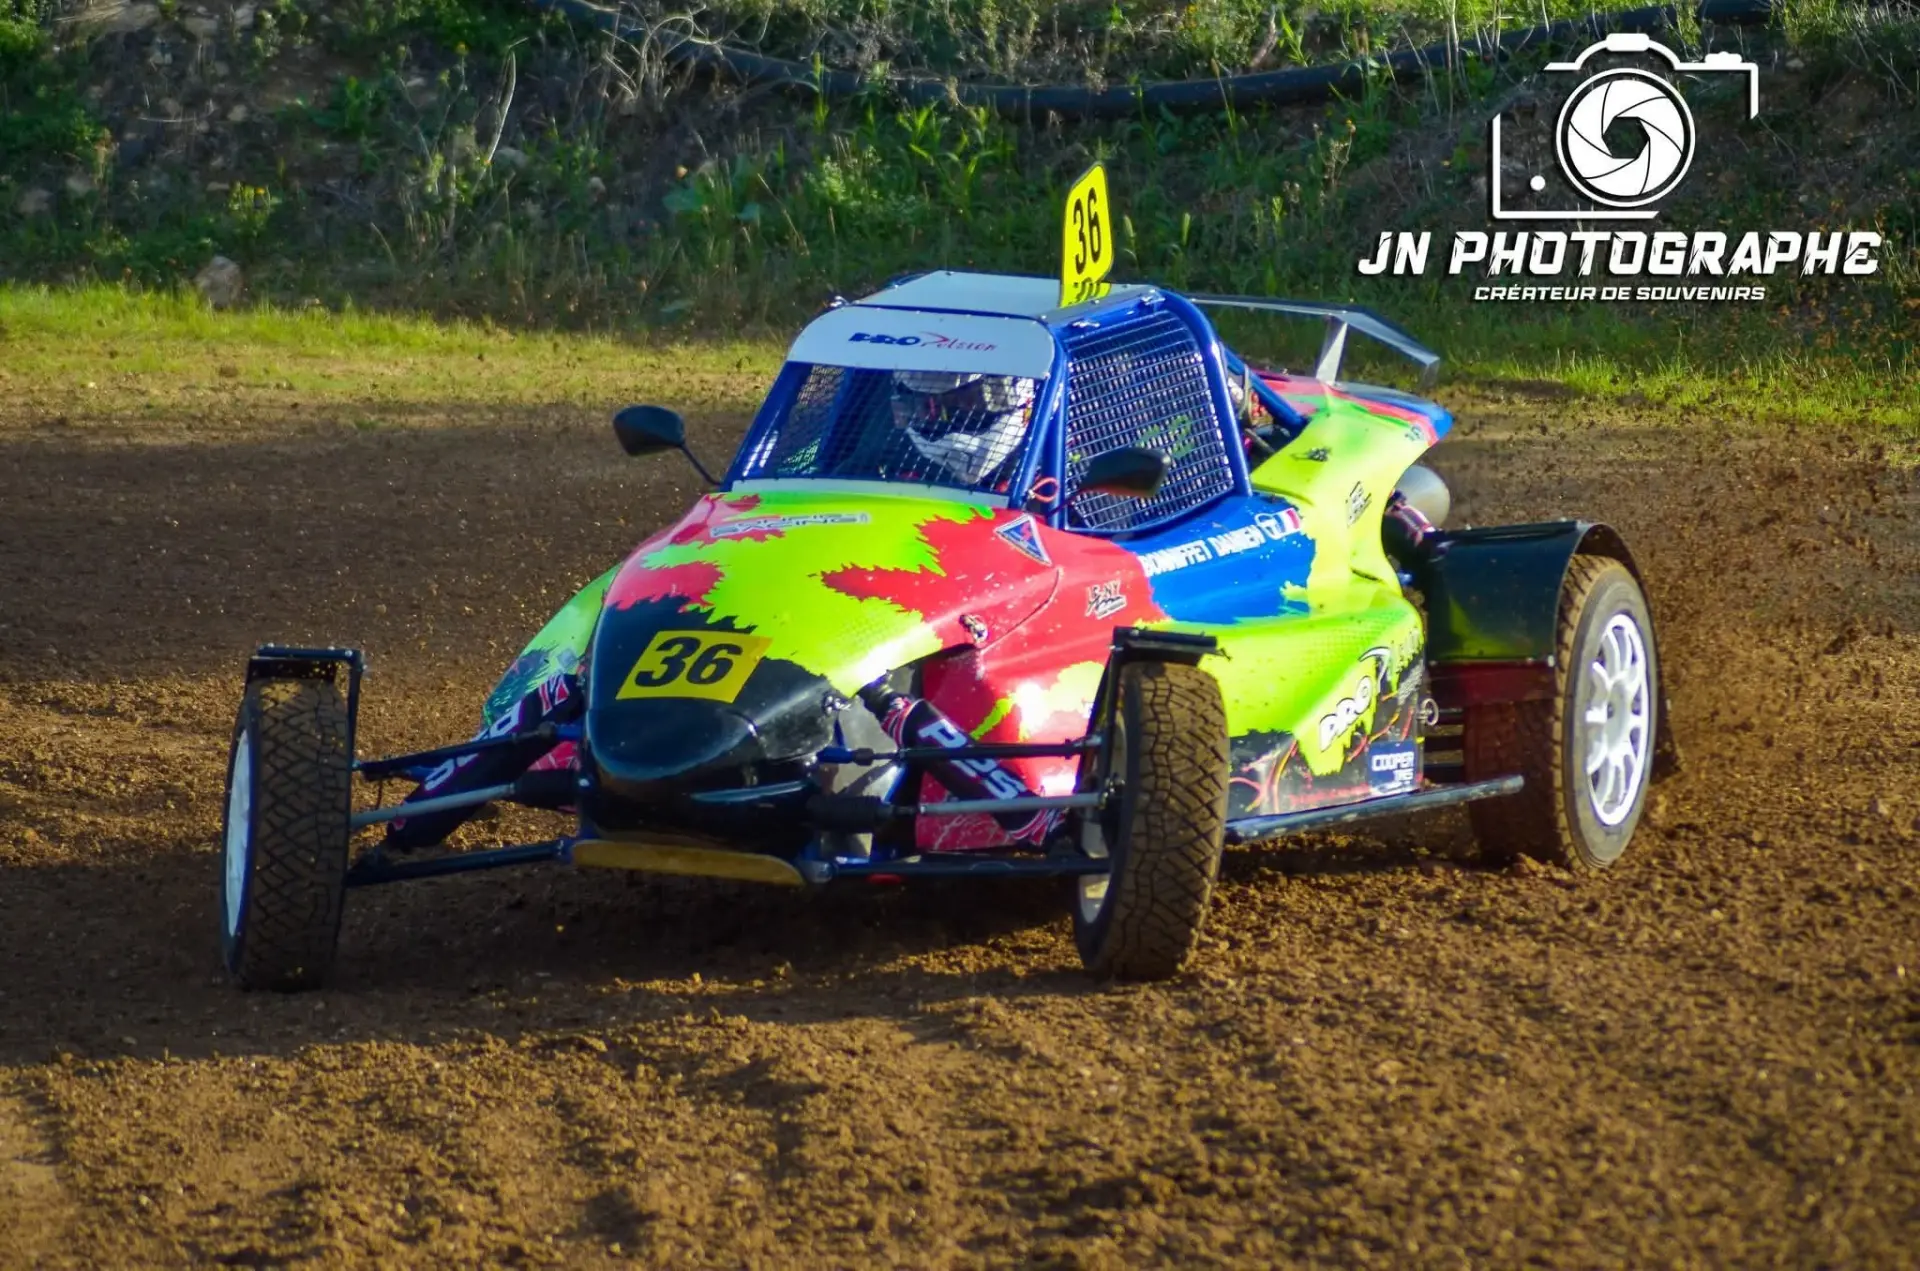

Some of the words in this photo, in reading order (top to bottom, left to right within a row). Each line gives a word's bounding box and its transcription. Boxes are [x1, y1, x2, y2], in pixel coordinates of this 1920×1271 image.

[1073, 187, 1102, 275] 36
[634, 635, 744, 688] 36
[1371, 751, 1415, 772] COOPER
